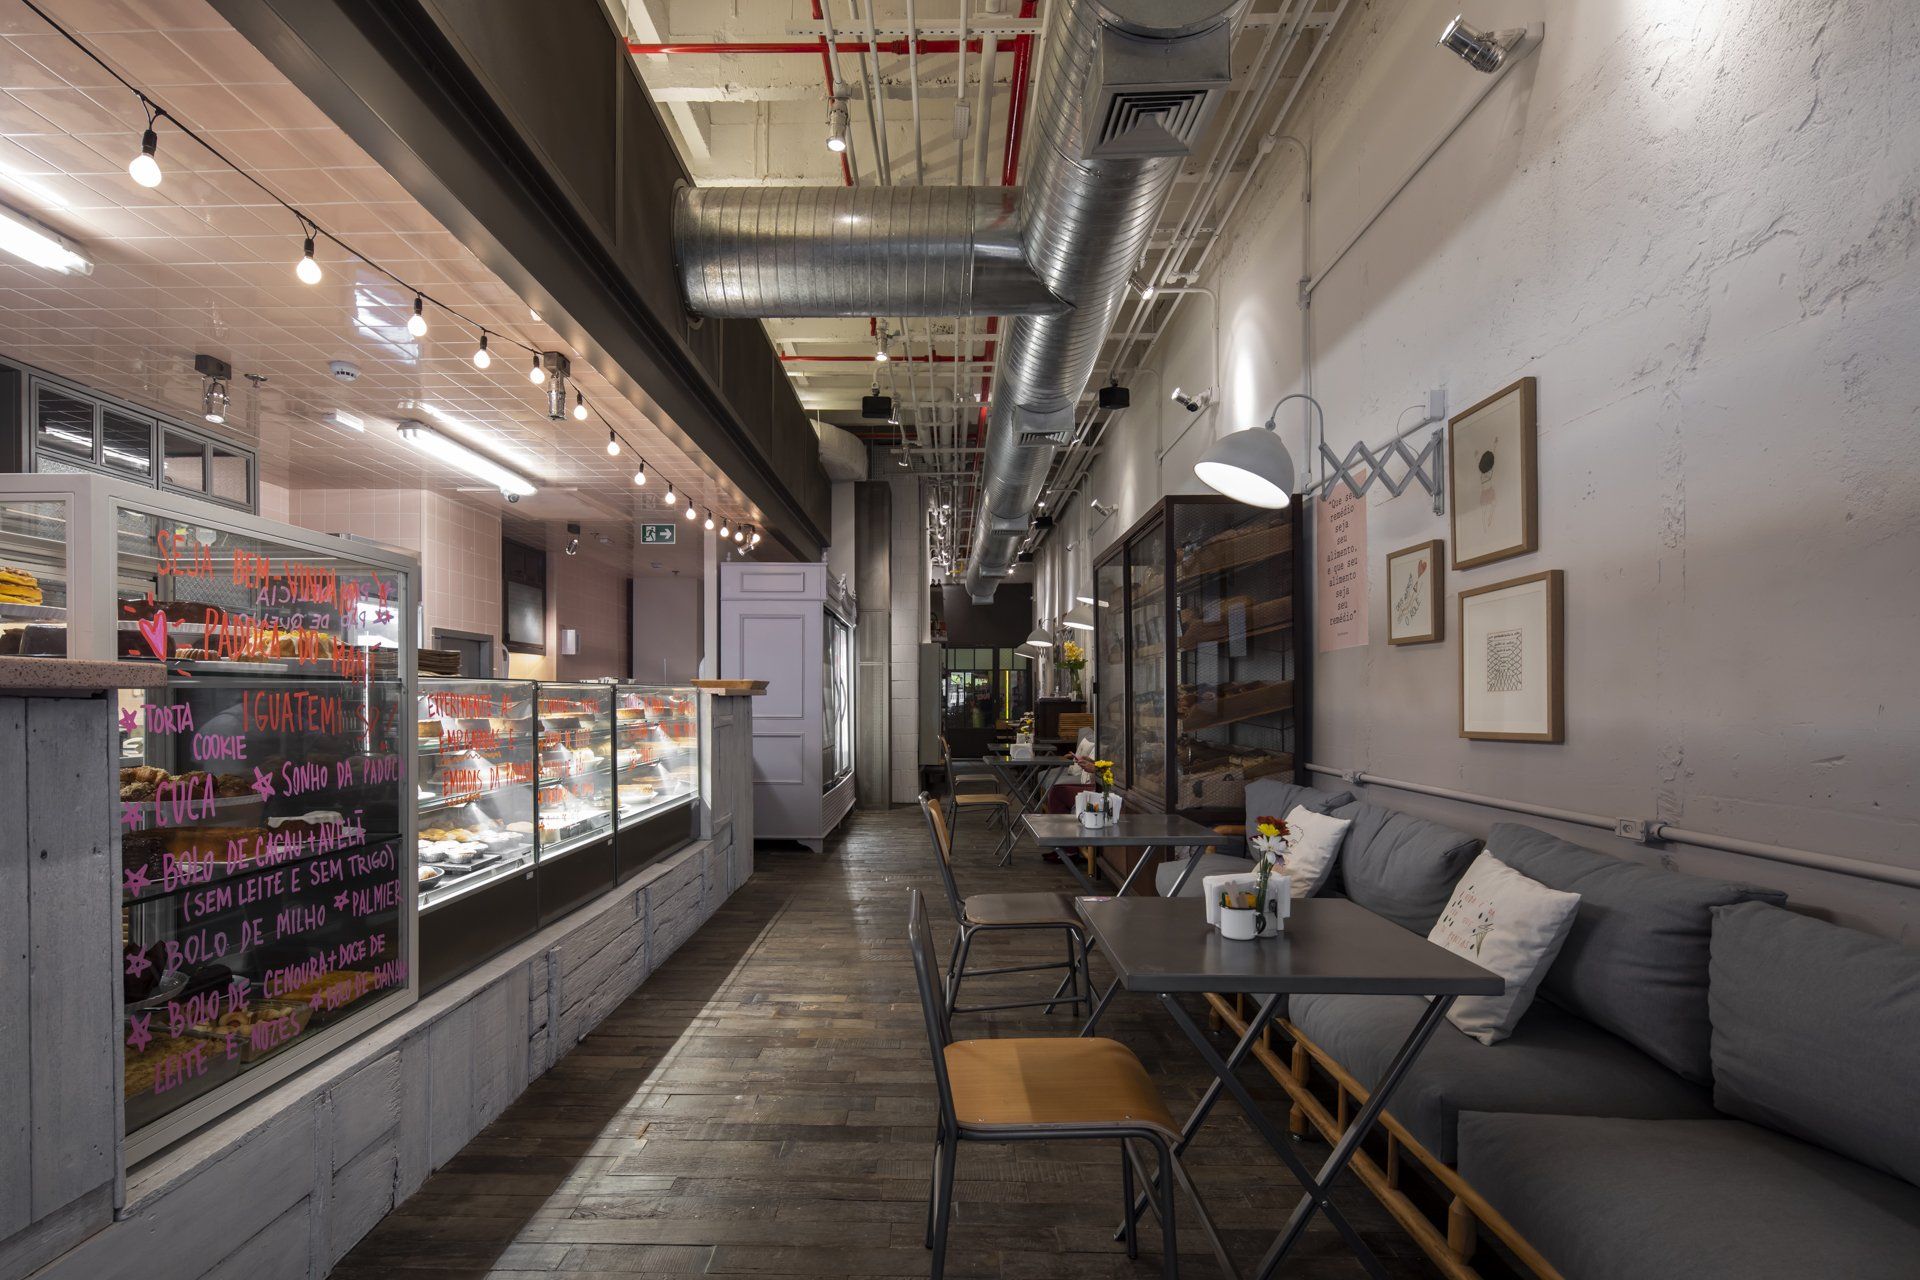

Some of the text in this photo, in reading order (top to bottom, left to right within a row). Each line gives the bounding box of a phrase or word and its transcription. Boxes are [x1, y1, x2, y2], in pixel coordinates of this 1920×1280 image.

[1330, 504, 1355, 522] remédio
[1335, 522, 1349, 534] seja
[157, 530, 214, 581] SEJA
[1336, 536, 1348, 546] seu
[1328, 572, 1357, 588] alimento
[1333, 563, 1344, 574] que
[1346, 556, 1358, 567] seu
[1335, 587, 1350, 599] seja
[1337, 601, 1348, 611] seu
[204, 608, 280, 661] PADOCA
[298, 628, 319, 665] DO
[140, 702, 194, 734] TORTA
[243, 691, 343, 735] IGUATEMI
[193, 734, 247, 760] COOKIE
[282, 761, 329, 797] SONHO
[336, 759, 352, 789] DA
[155, 774, 215, 827] CUCA
[163, 846, 214, 893] BOLO
[227, 838, 249, 875] DE
[256, 831, 302, 867] CACAU
[184, 844, 394, 921] (SEM LEITE E SEM TRIGO)
[166, 906, 326, 977] BOLO DE MILHO
[168, 989, 219, 1038] BOLO
[228, 978, 250, 1013] DE
[263, 952, 327, 998] CENOURA
[339, 940, 366, 969] DOCE
[370, 934, 385, 958] DE
[154, 1010, 300, 1095] LEITE E NOZES
